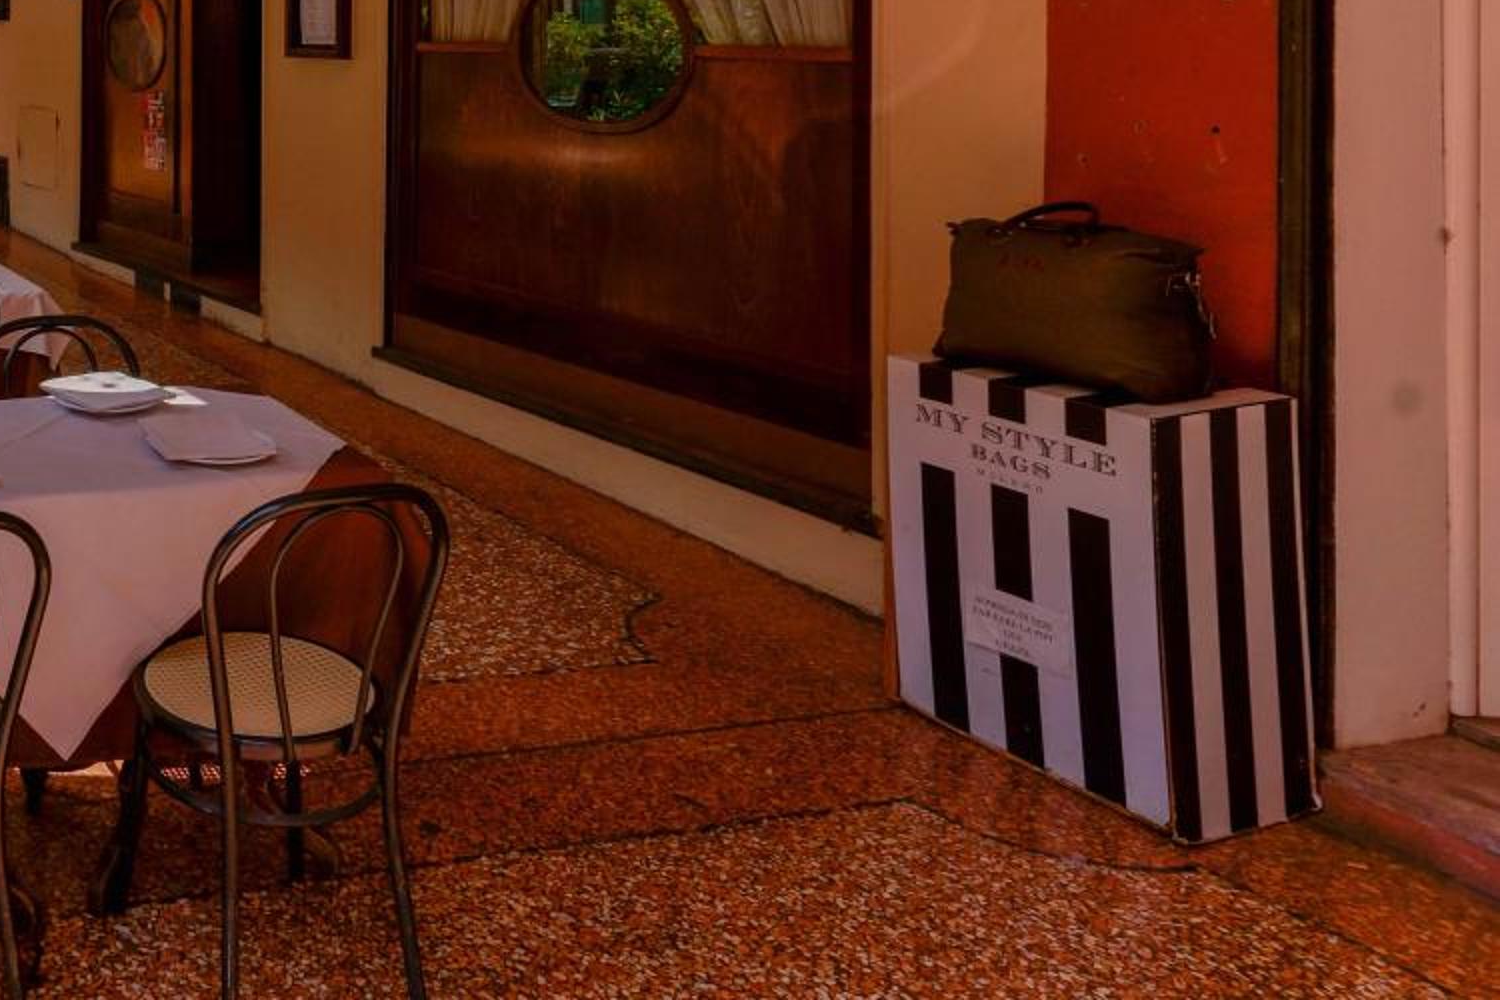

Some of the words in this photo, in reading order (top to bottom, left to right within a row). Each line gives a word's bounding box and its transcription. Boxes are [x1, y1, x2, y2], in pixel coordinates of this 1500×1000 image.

[915, 403, 969, 434] MY
[980, 420, 1117, 477] STYLE
[970, 443, 1051, 479] BAGS
